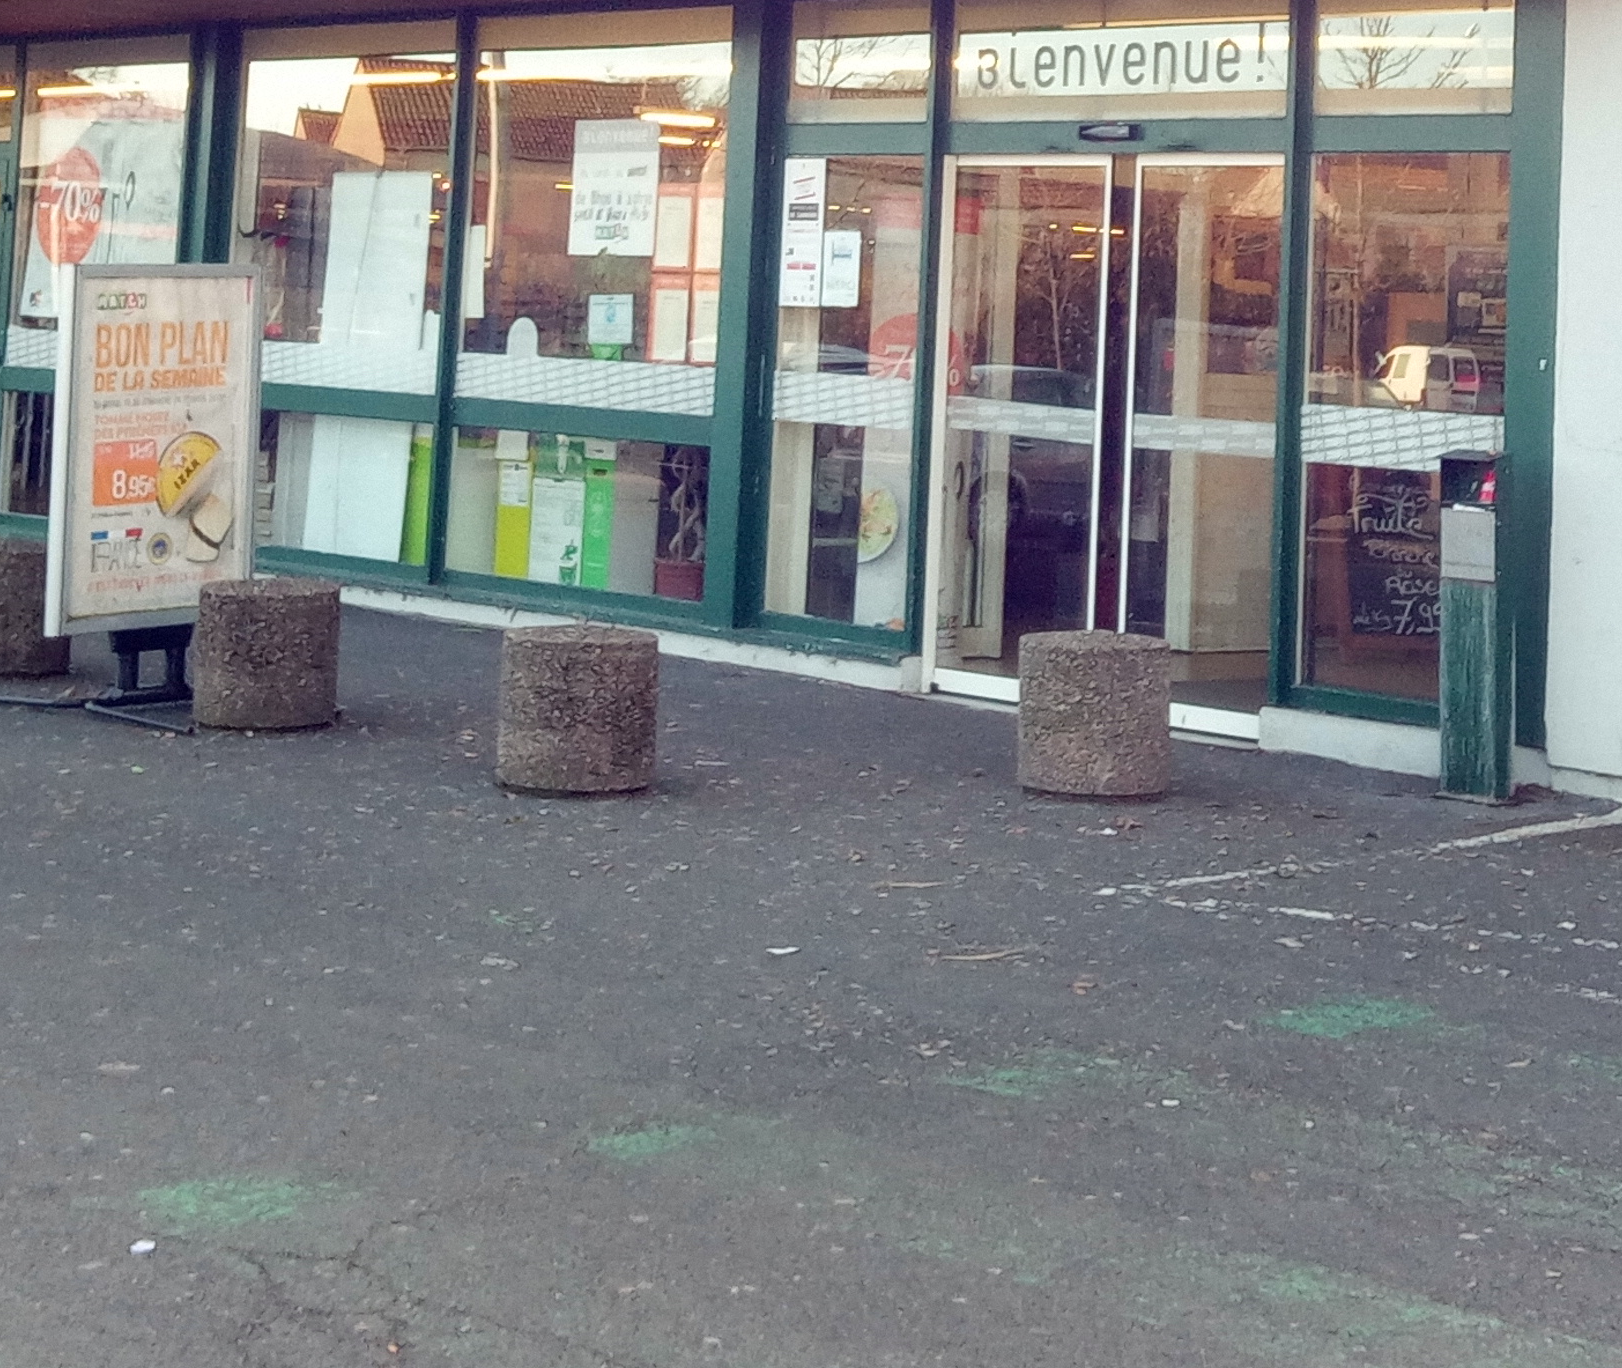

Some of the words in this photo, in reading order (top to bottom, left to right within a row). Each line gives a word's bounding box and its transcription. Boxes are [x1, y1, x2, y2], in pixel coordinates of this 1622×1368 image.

[94, 322, 151, 369] BON
[159, 319, 229, 366] PLAN
[93, 371, 117, 393] DE
[122, 370, 146, 391] LA
[149, 367, 227, 390] SEMAINE
